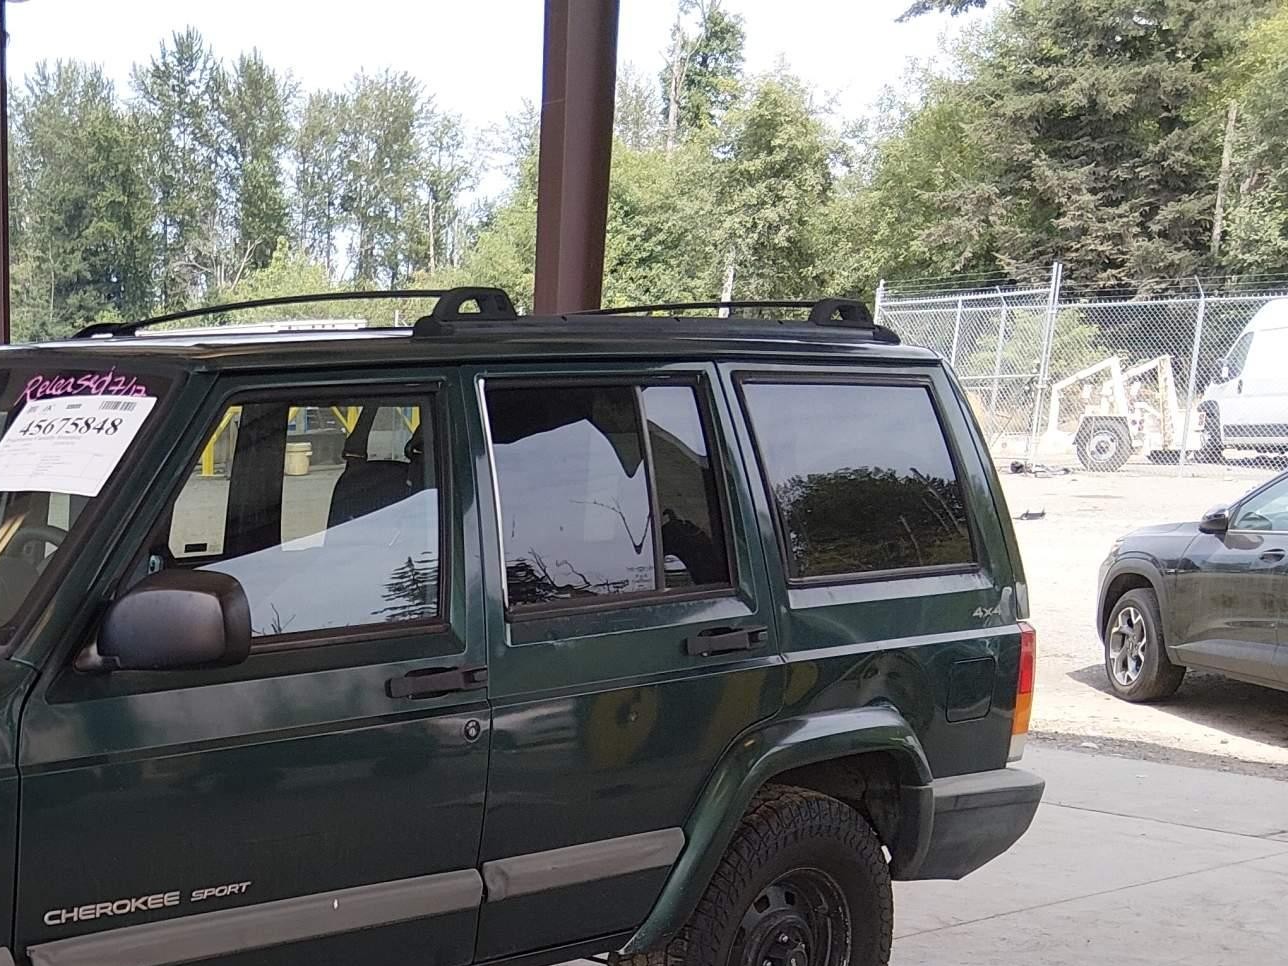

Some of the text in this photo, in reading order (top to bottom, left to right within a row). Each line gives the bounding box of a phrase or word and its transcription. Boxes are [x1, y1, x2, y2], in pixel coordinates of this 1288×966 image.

[20, 416, 124, 436] 45675848
[43, 881, 252, 926] CHEROKEE SPORT
